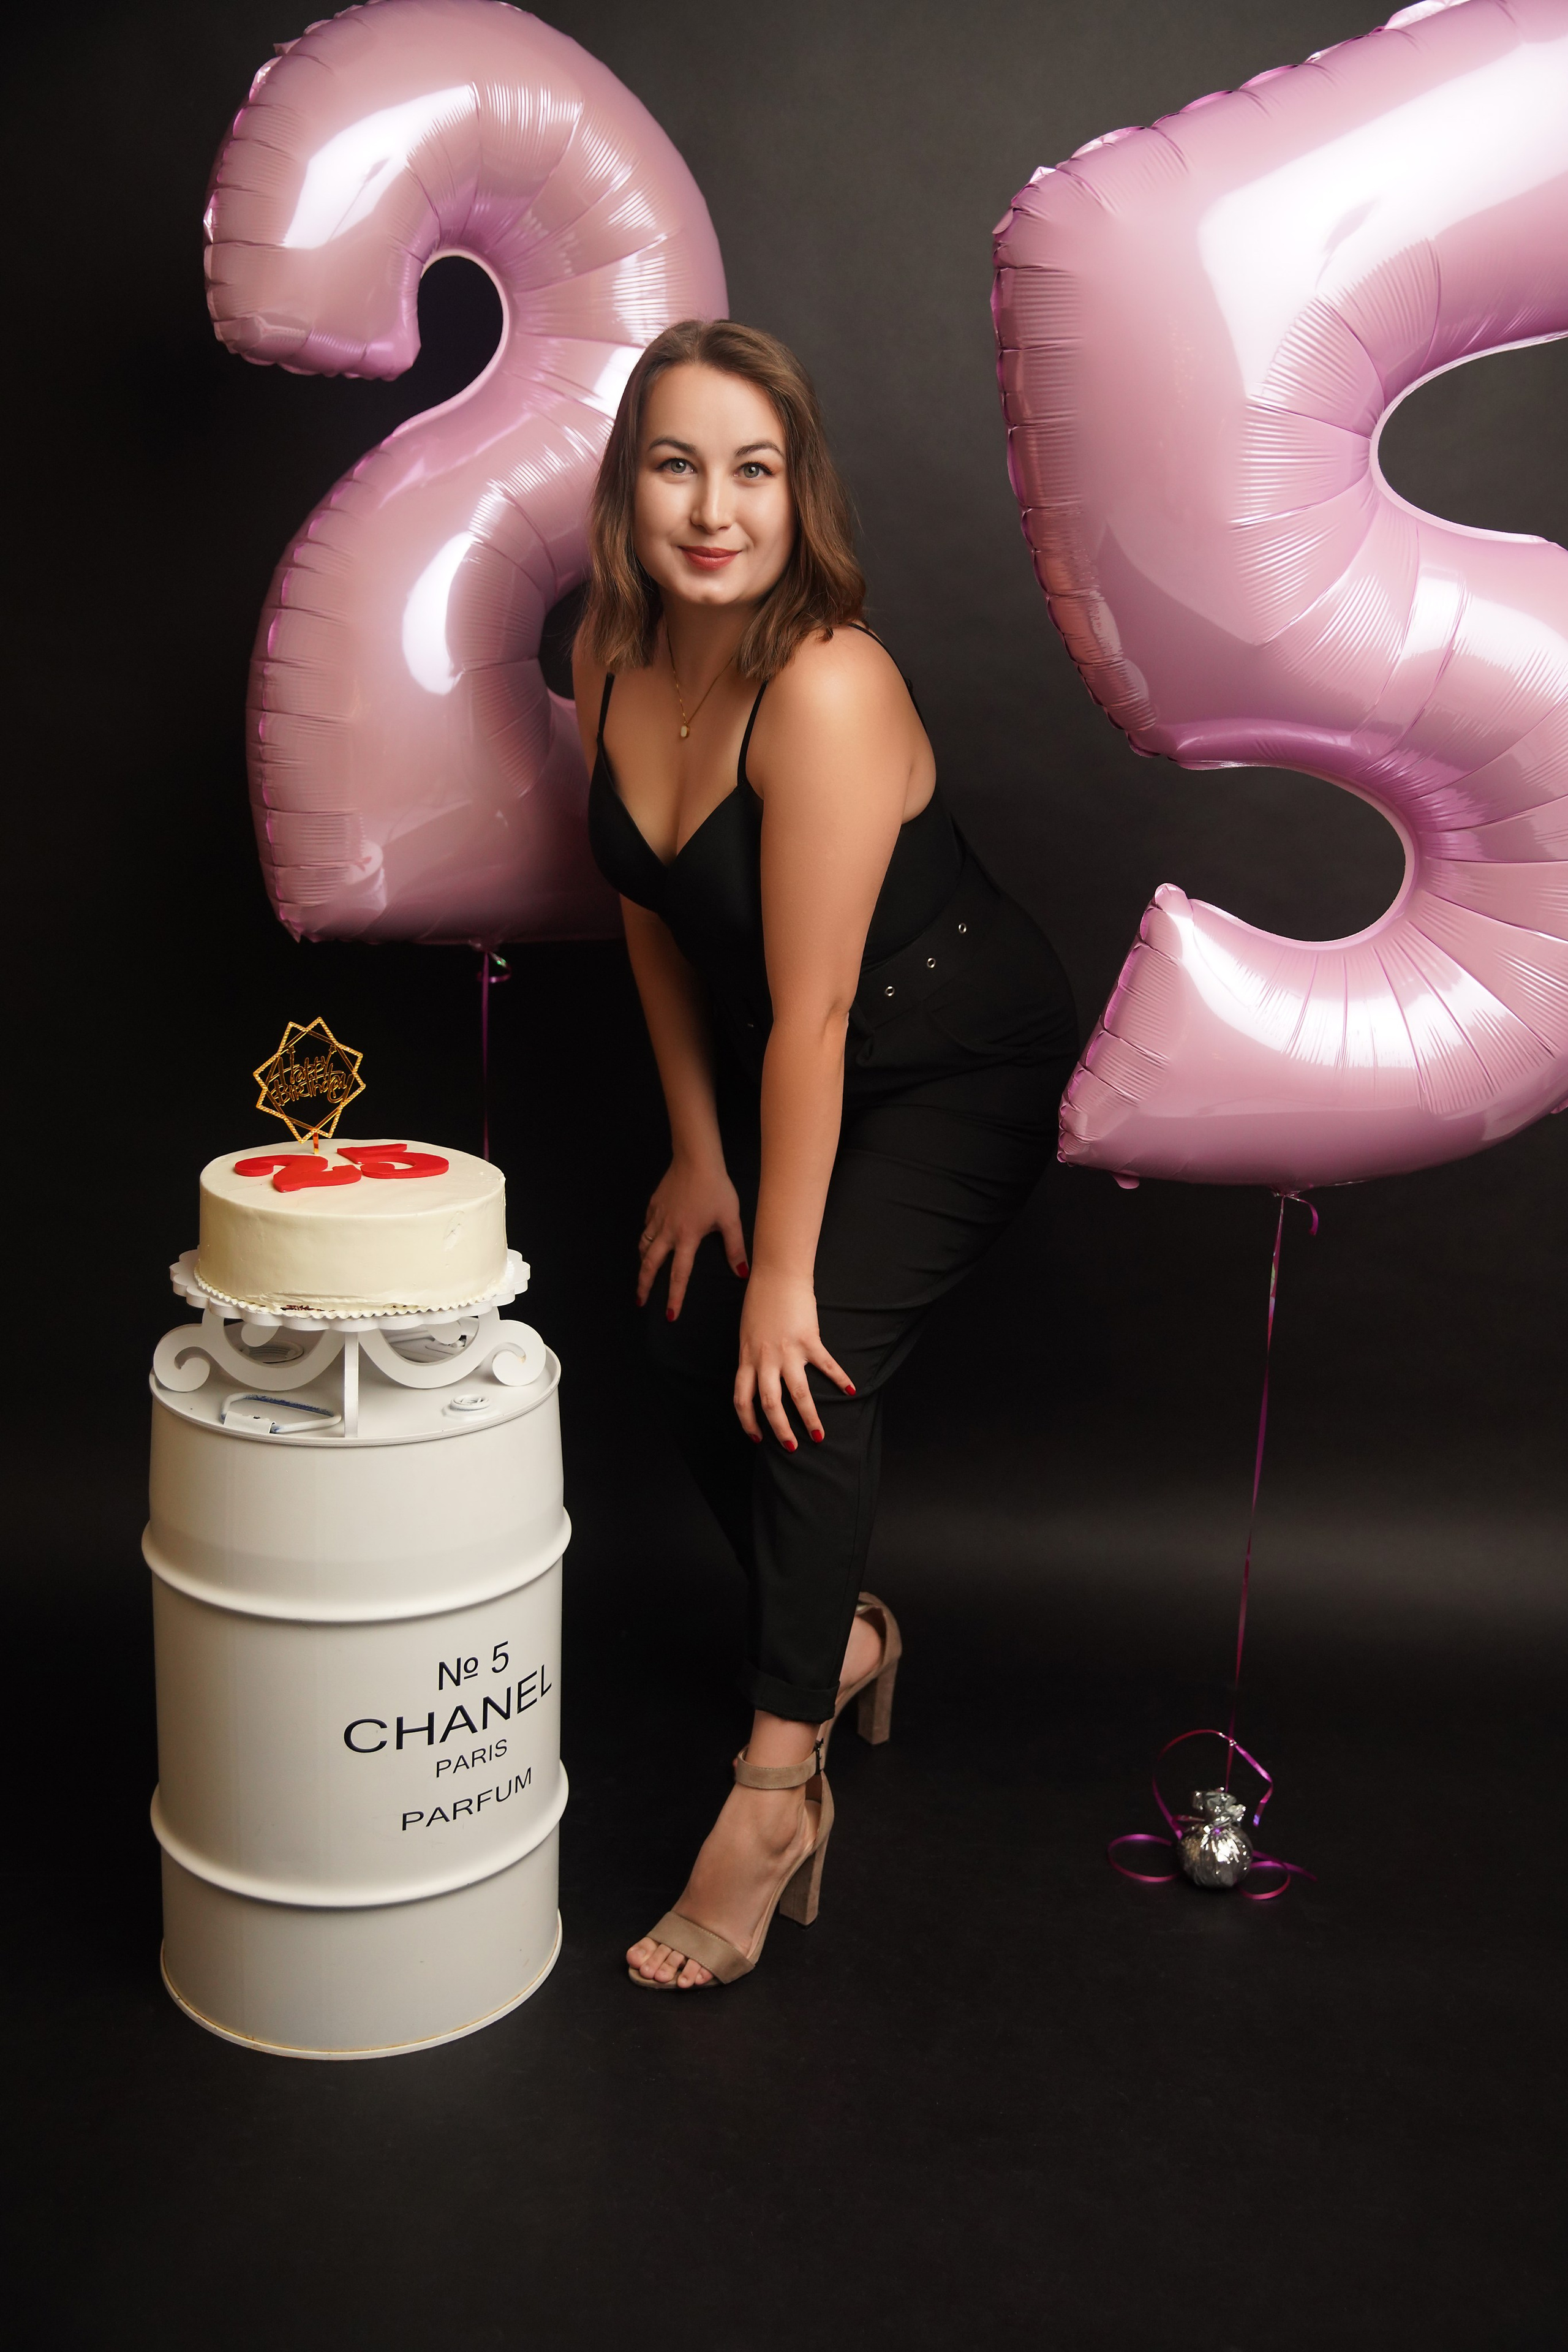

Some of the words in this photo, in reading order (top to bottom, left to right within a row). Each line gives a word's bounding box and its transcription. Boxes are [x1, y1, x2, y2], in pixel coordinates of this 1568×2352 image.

[203, 0, 729, 946] 2
[990, 0, 1568, 1188] 5
[233, 1143, 450, 1193] 25
[491, 1640, 510, 1673] 5
[343, 1664, 552, 1754] CHANEL
[436, 1738, 508, 1778] PARIS
[402, 1766, 532, 1831] PARFUM
